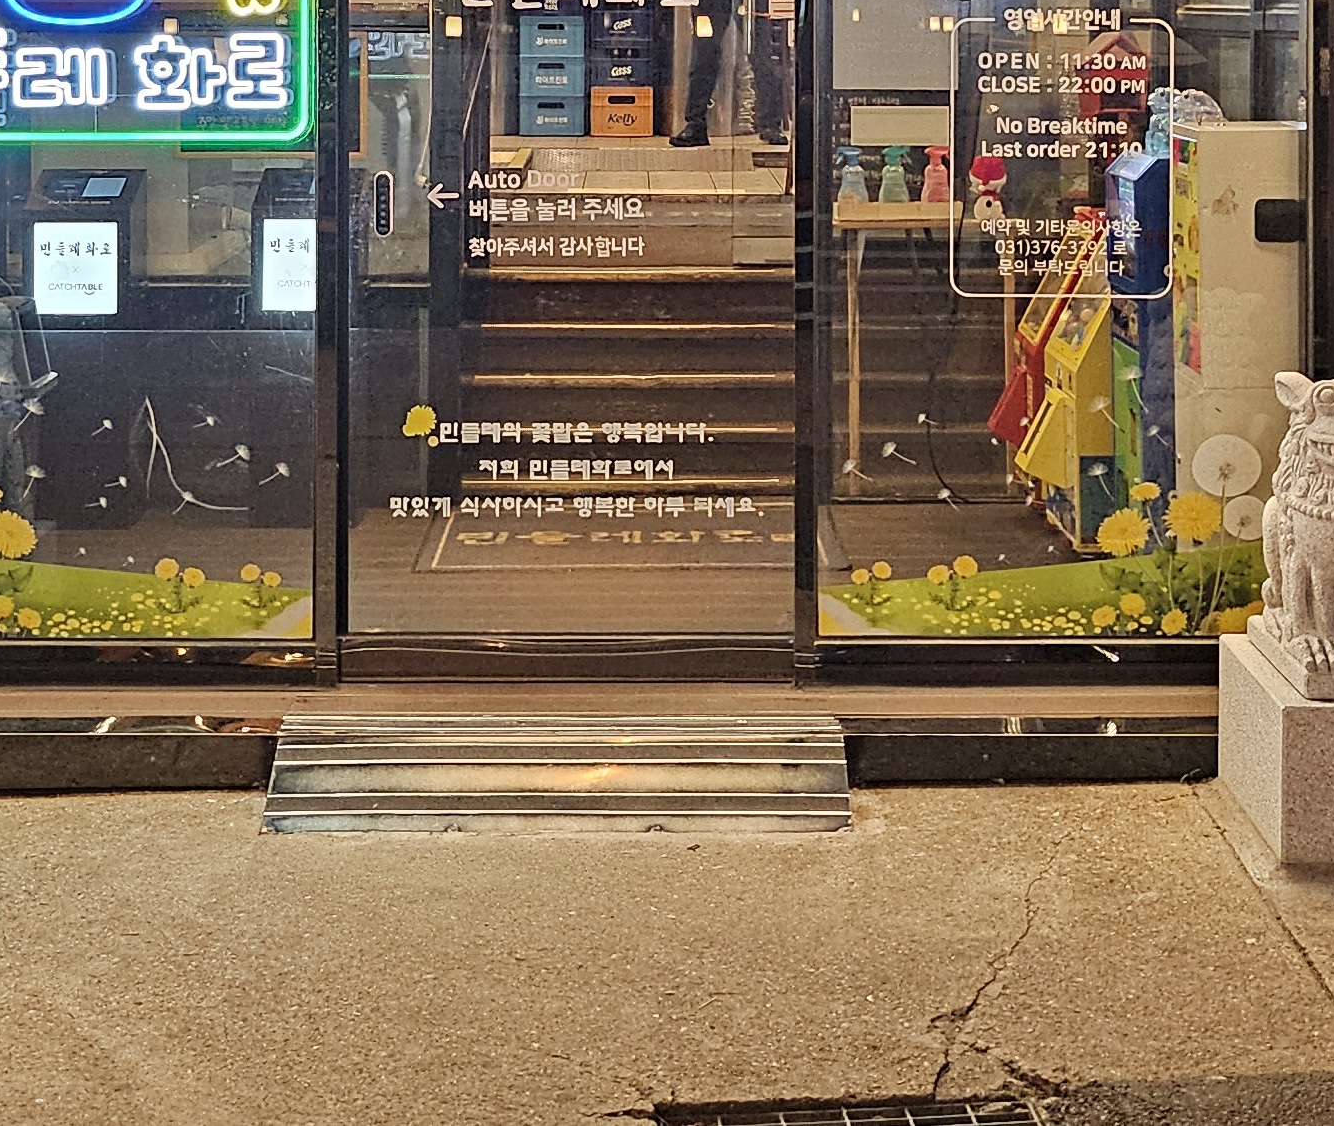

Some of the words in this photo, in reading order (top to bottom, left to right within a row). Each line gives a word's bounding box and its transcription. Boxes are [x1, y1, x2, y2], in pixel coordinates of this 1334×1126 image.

[977, 52, 1040, 70] OPEN
[1059, 53, 1117, 71] 11:30
[1120, 55, 1147, 70] AM
[133, 31, 291, 112] 화로
[977, 75, 1042, 94] CLOSE
[1058, 76, 1117, 94] 22:00
[1120, 79, 1147, 94] PM
[607, 112, 639, 128] Kelly
[996, 116, 1023, 135] No
[1027, 116, 1129, 135] Breaktime
[980, 140, 1023, 158] Last
[1026, 140, 1081, 158] order
[467, 170, 522, 190] Auto
[526, 170, 580, 188] Door
[468, 198, 531, 222] 버튼을
[535, 198, 577, 221] 눌러
[582, 197, 645, 221] 주세요
[980, 220, 1012, 236] 예약
[1015, 220, 1031, 236] 및
[39, 241, 113, 256] 민들레화로
[468, 236, 555, 258] 찾아주셔서
[558, 236, 646, 258] 감사합니다
[994, 239, 1108, 257] 031)376-3392
[1111, 241, 1128, 256] 로
[997, 259, 1029, 277] 문의
[1032, 259, 1125, 277] 부탁드립니다
[48, 282, 104, 292] CATCHTABLE
[439, 422, 521, 444] 민들레의
[531, 422, 594, 444] 꽃말은
[601, 421, 715, 444] 행복입니다.
[478, 459, 519, 481] 저희
[528, 459, 675, 481] 민들레화로에서
[389, 496, 452, 518] 맛있게
[460, 496, 565, 518] 식사하시고
[572, 496, 636, 518] 행복한
[643, 496, 686, 518] 하루
[693, 496, 765, 518] 되세요.
